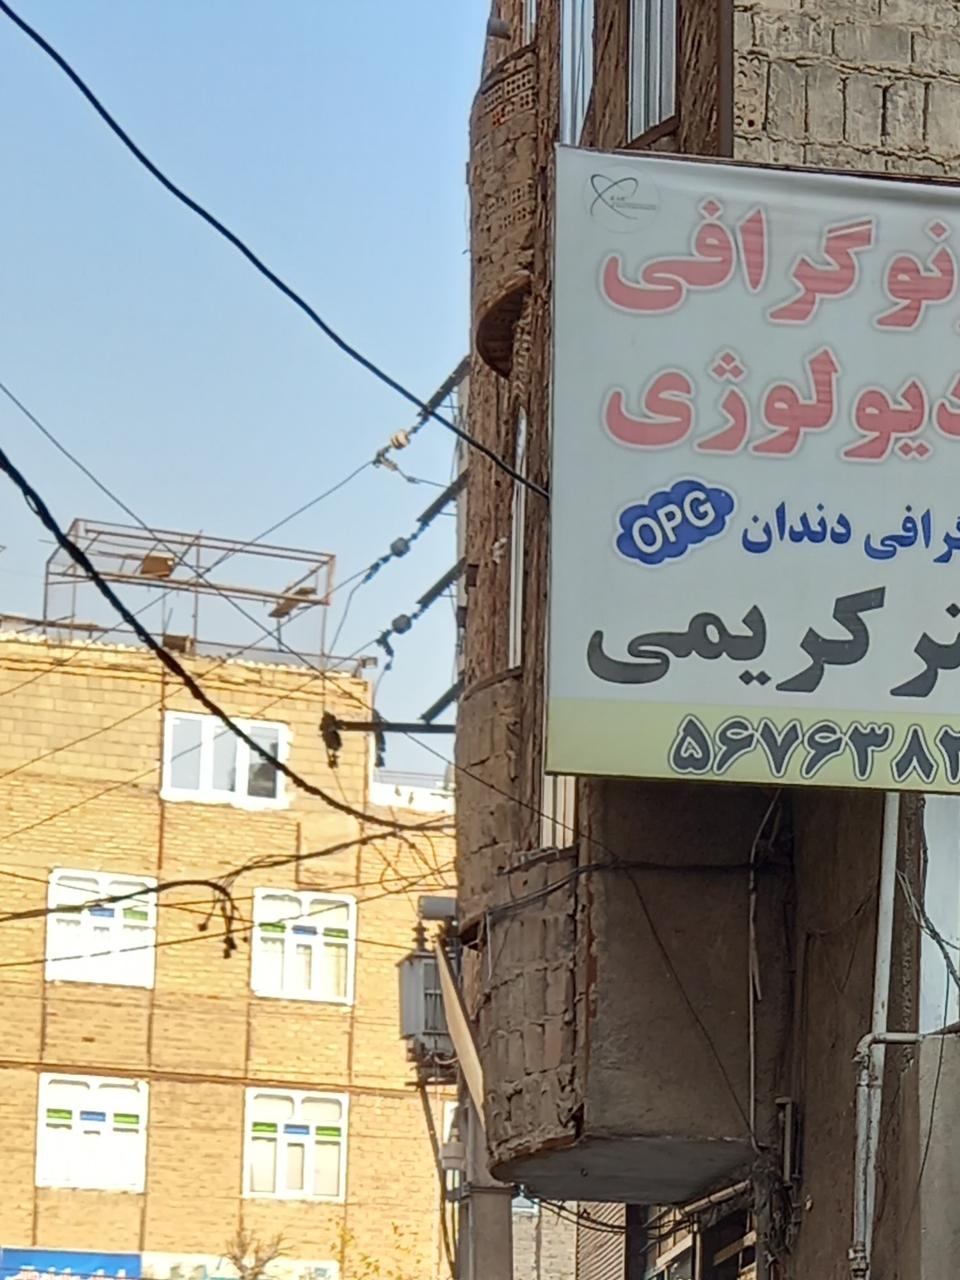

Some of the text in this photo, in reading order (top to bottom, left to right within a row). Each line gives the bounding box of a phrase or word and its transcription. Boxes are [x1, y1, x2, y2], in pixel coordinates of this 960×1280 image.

[631, 489, 717, 556] OPG
[742, 501, 851, 553] دندان
[587, 583, 886, 693] کریمی
